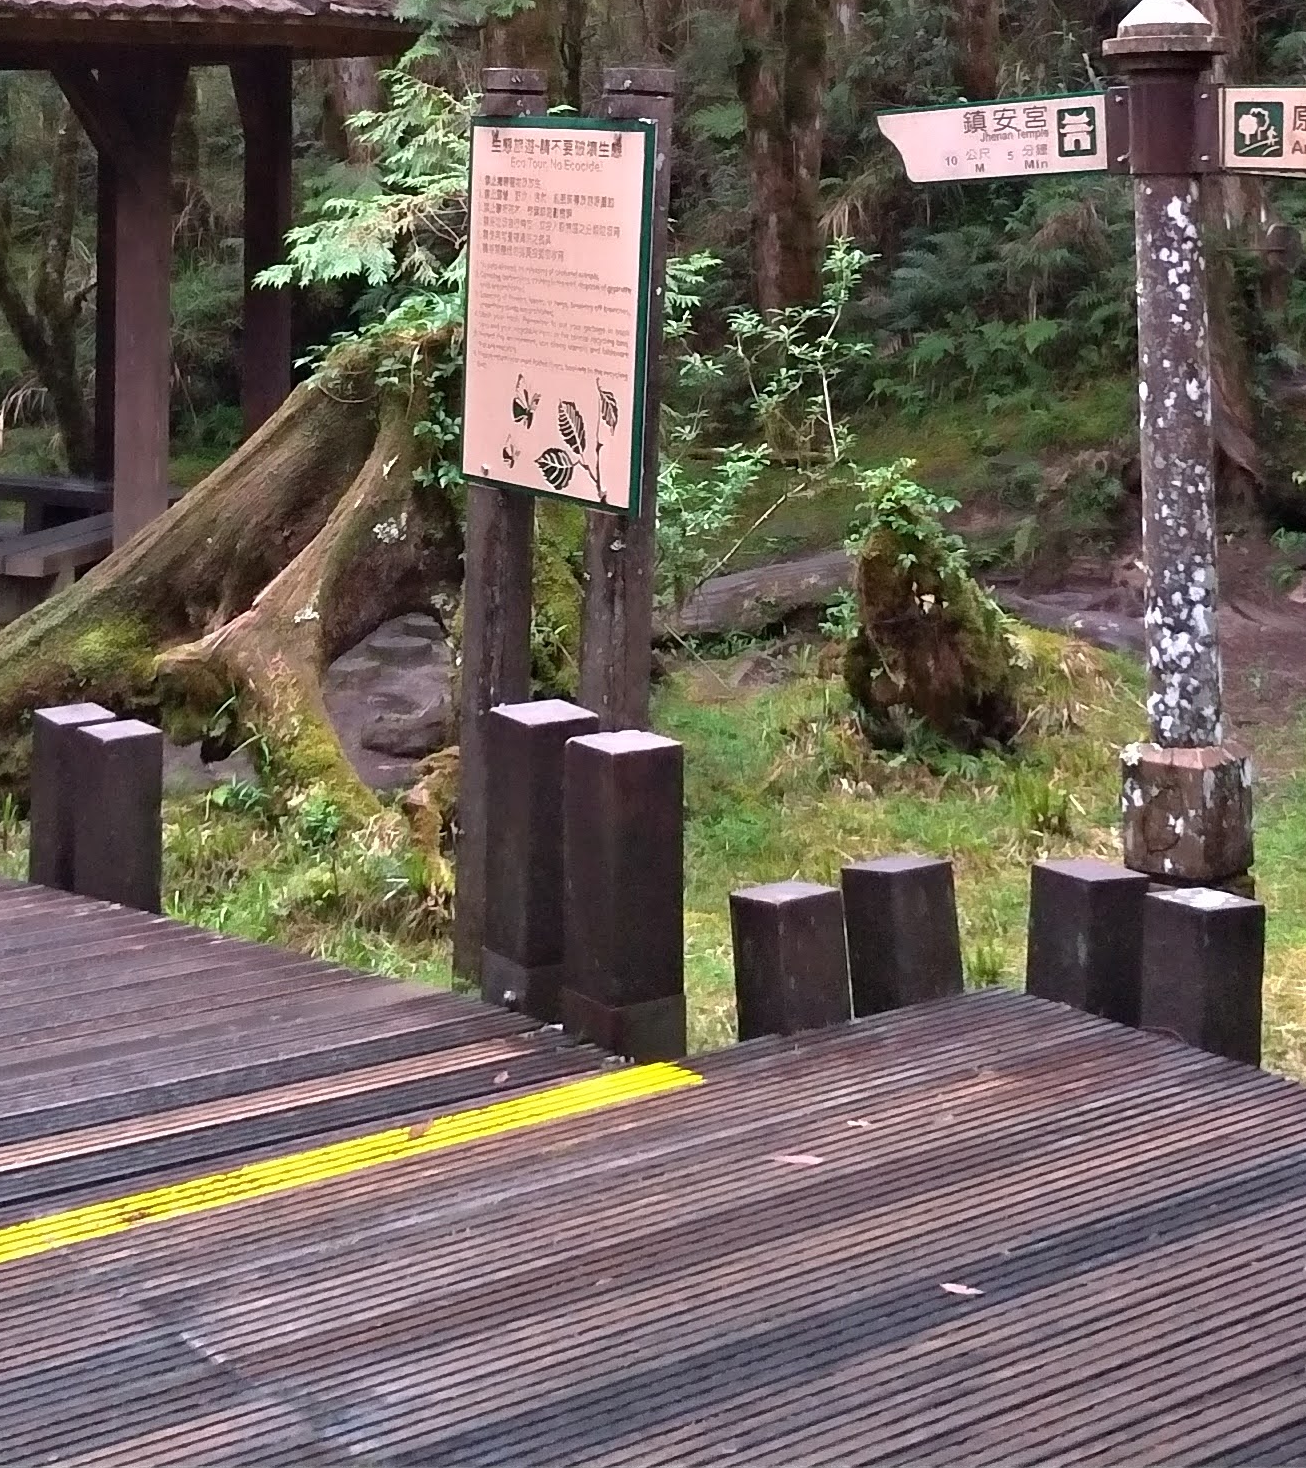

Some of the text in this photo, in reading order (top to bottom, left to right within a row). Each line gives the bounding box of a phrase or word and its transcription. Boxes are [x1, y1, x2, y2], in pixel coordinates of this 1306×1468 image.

[962, 105, 1048, 134] 鎮安宮
[1017, 129, 1049, 141] Temple
[965, 148, 991, 161] 公尺
[1007, 151, 1014, 161] 5
[1022, 144, 1048, 157] 分鐘
[975, 160, 1049, 173] M Min
